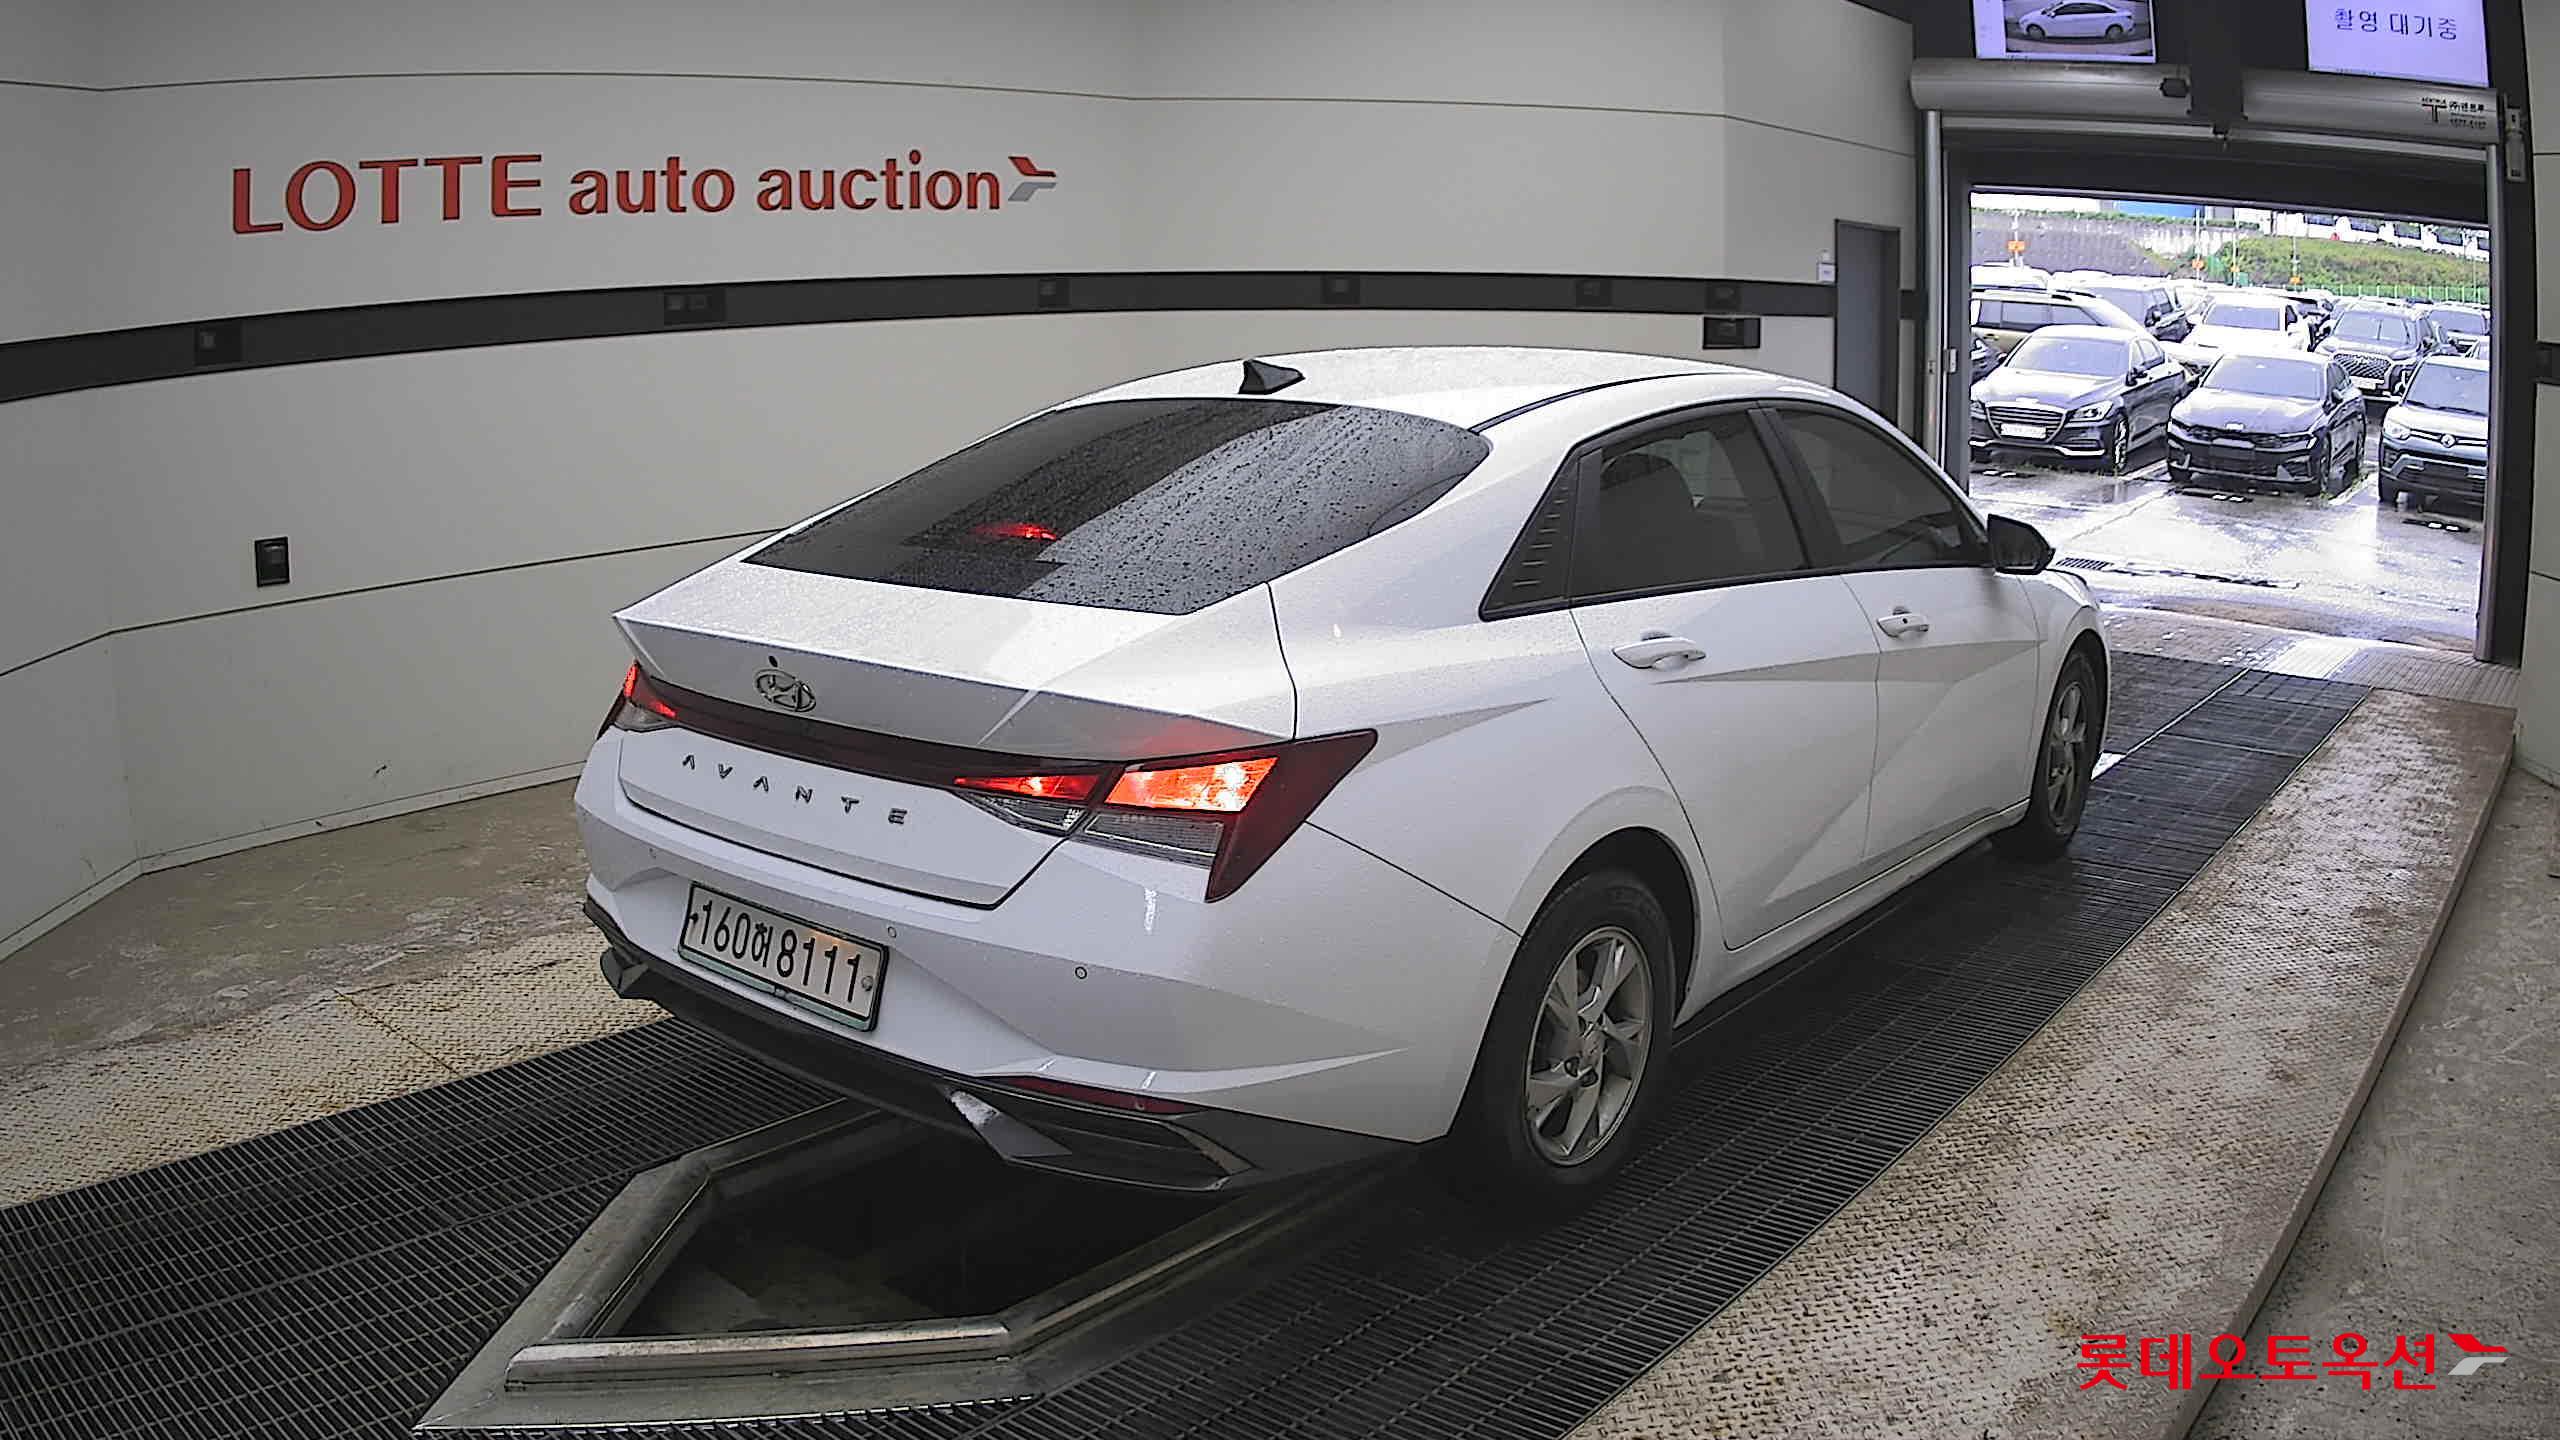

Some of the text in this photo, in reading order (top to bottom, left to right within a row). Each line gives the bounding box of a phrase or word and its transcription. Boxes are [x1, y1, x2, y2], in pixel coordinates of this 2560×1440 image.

[2335, 8, 2457, 41] 촬영 대기중
[233, 150, 1001, 234] LOTTE auto auction
[682, 754, 908, 825] AVANTE
[701, 899, 861, 1003] 160허8111
